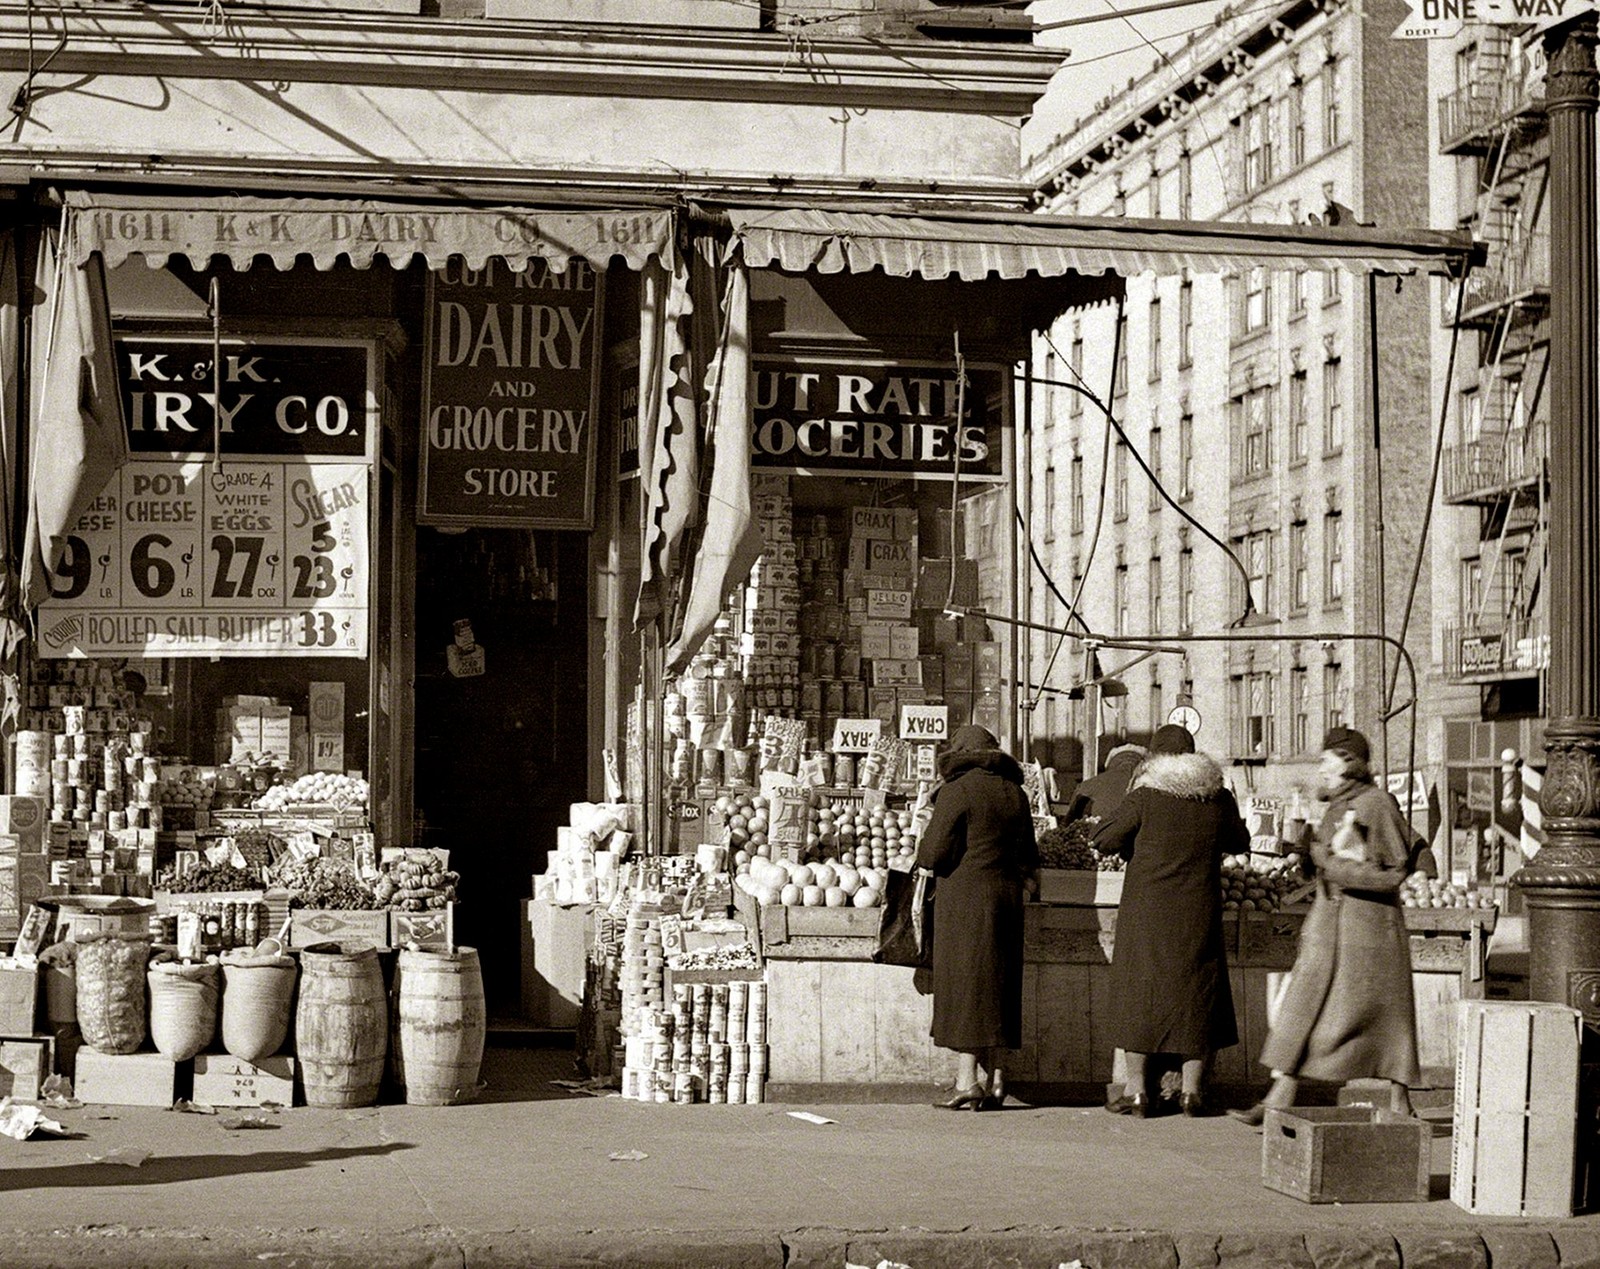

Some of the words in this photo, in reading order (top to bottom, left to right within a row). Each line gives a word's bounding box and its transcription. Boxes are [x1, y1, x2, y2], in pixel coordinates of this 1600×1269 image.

[1423, 0, 1479, 20] ONE
[1513, 0, 1567, 17] WAY
[1405, 28, 1440, 36] DEPT
[103, 212, 171, 241] 1611
[214, 213, 238, 242] K
[245, 220, 259, 236] &
[270, 214, 295, 242] K
[329, 214, 442, 243] DAIRY
[595, 215, 657, 244] 1611
[436, 301, 594, 370] DAIRY
[489, 381, 537, 398] AND
[751, 370, 820, 412] UT
[835, 374, 972, 418] RATE
[130, 391, 256, 433] IRY
[274, 395, 359, 437] CO.
[429, 405, 588, 454] GROCERY
[752, 418, 989, 463] OCERIES
[133, 474, 188, 496] POT
[211, 472, 258, 493] GRADE
[463, 468, 558, 498] STORE
[215, 494, 272, 506] WHITE
[290, 478, 361, 529] SUGAR
[126, 501, 197, 523] CHEESE
[211, 515, 273, 531] EGGS
[854, 511, 891, 529] CRAX
[310, 520, 337, 553] 5
[873, 544, 909, 562] CRAX
[89, 616, 157, 644] ROLLED
[165, 616, 210, 644] SALT
[218, 617, 294, 645] BUTTER
[906, 716, 945, 734] CRAX
